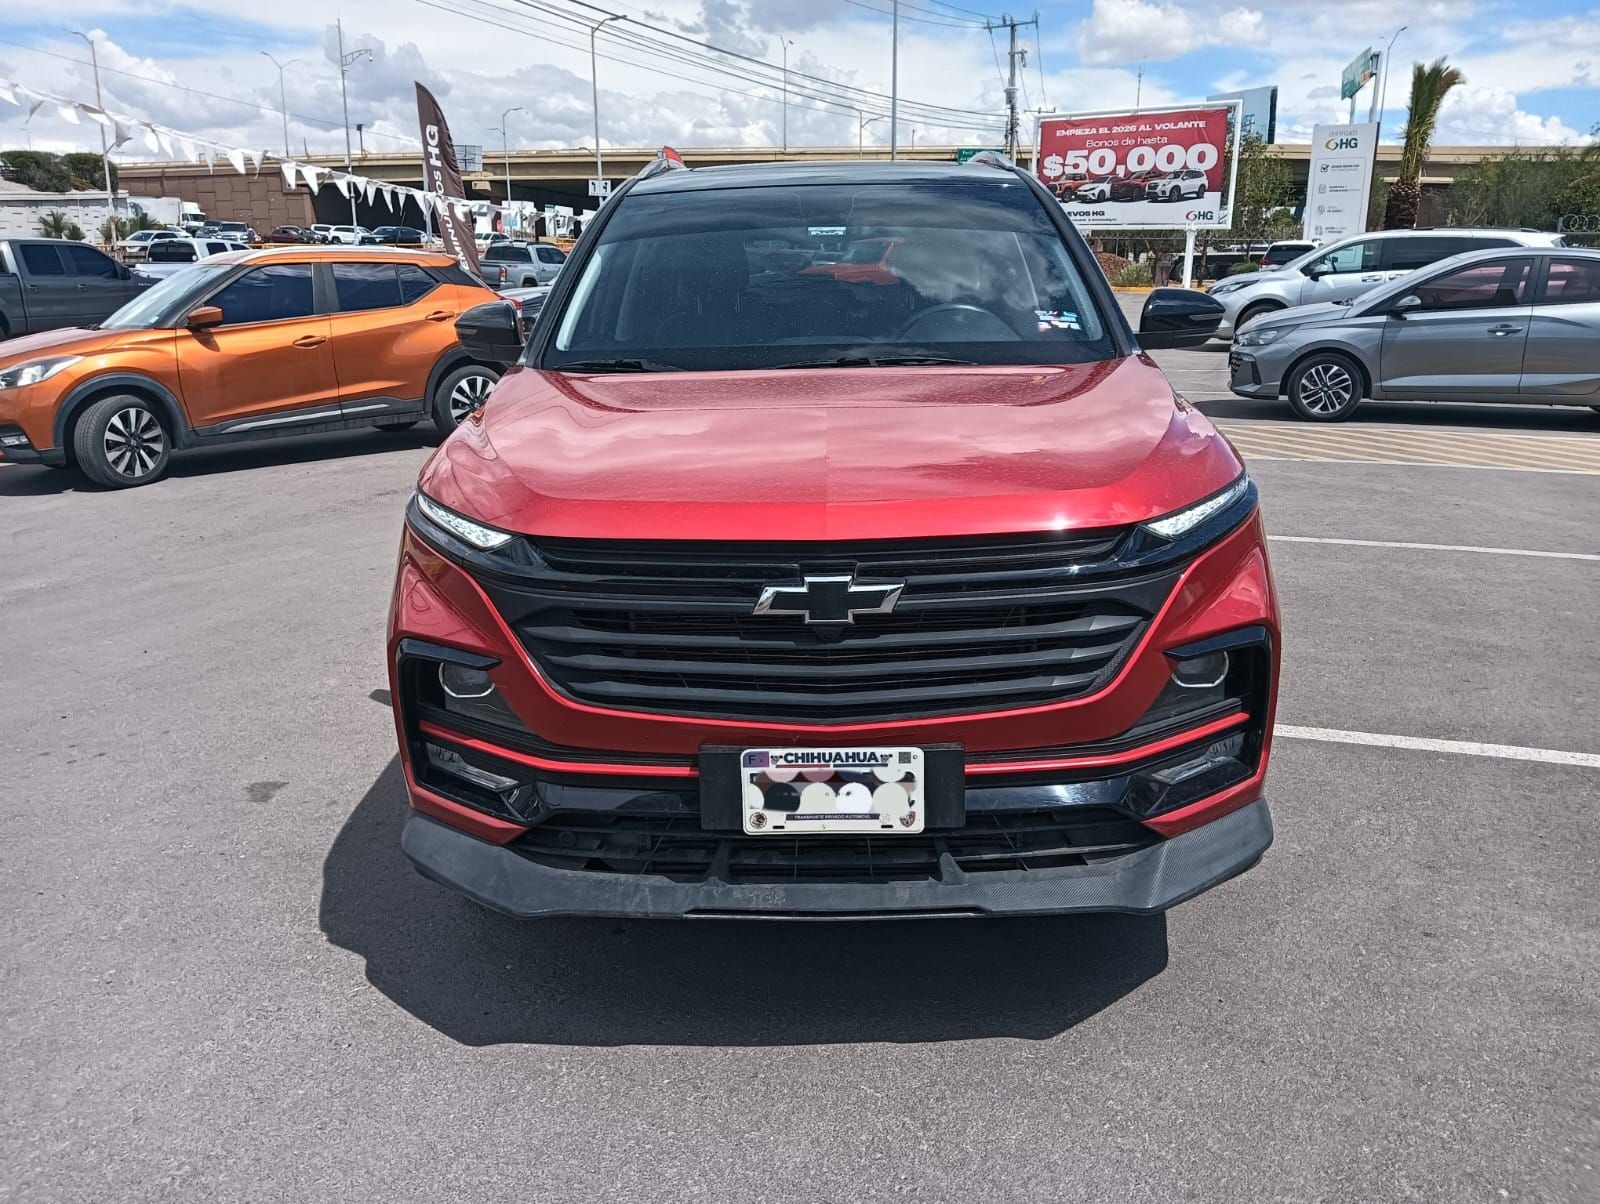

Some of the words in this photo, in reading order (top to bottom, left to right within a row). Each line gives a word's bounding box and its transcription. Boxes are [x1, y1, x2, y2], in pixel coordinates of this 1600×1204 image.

[1056, 127, 1097, 137] EMPIEZA
[1099, 126, 1111, 134] EL
[1112, 125, 1137, 134] 2026
[1138, 124, 1153, 132] AL
[1155, 121, 1207, 130] VOLANTE
[425, 124, 443, 167] HG
[1086, 138, 1119, 148] Bonos
[1121, 137, 1135, 146] de
[1137, 135, 1168, 145] hasta
[1339, 137, 1359, 150] HG
[1042, 143, 1219, 179] $50,000
[1197, 210, 1214, 221] HG
[783, 751, 879, 764] CHIHUAHUA
